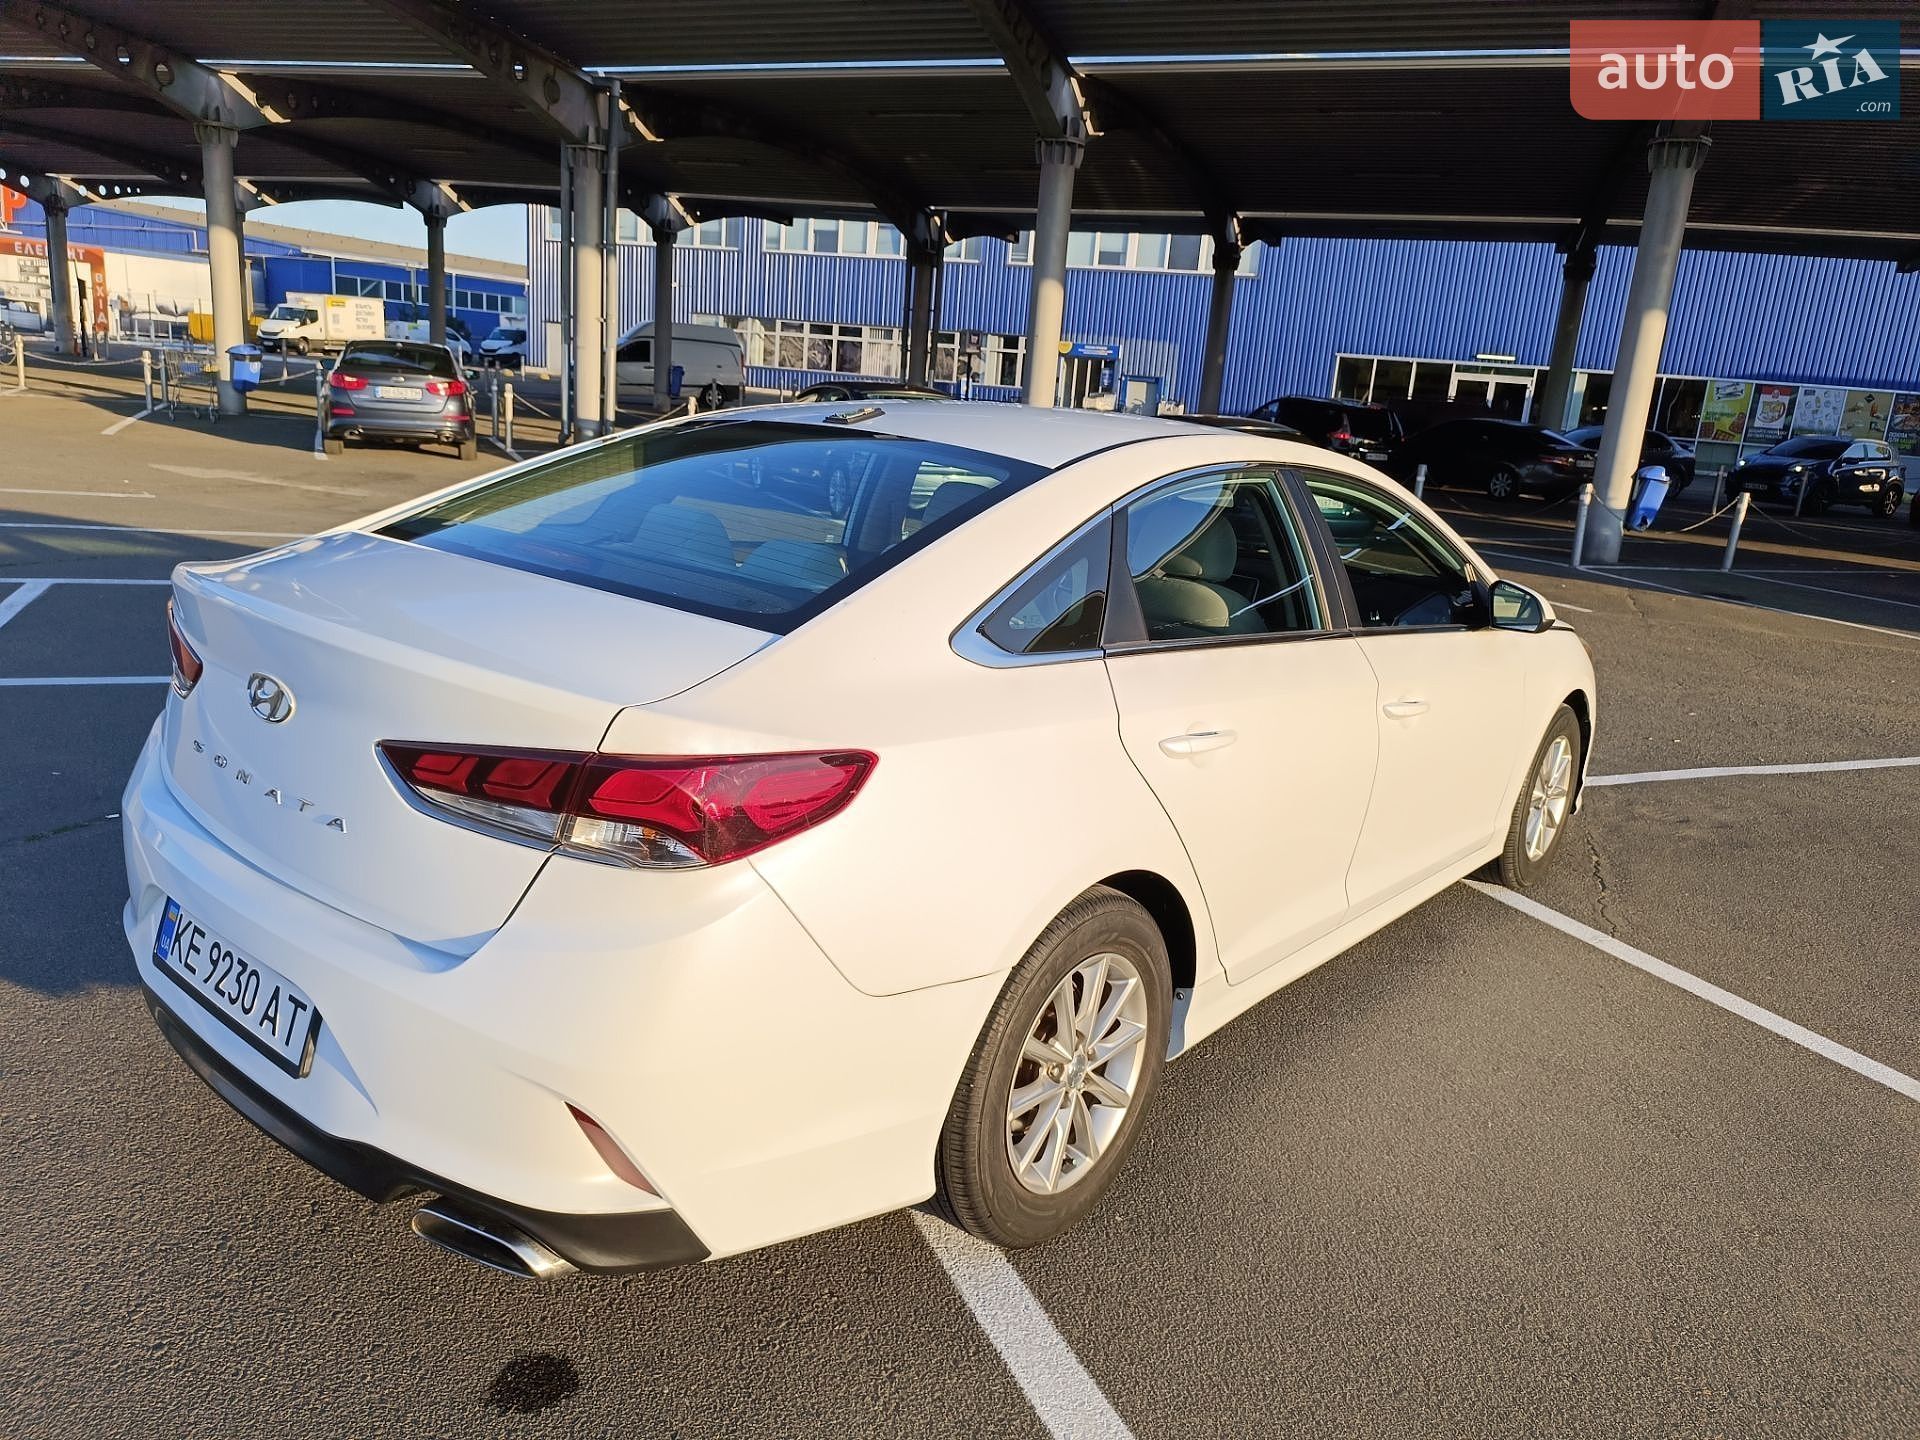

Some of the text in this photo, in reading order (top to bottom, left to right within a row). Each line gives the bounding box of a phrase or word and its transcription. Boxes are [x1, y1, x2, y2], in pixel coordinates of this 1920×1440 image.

[14, 241, 86, 261] ЕЛЕНТ
[192, 739, 347, 834] SONATA
[170, 913, 308, 1047] KE 9230 AT
